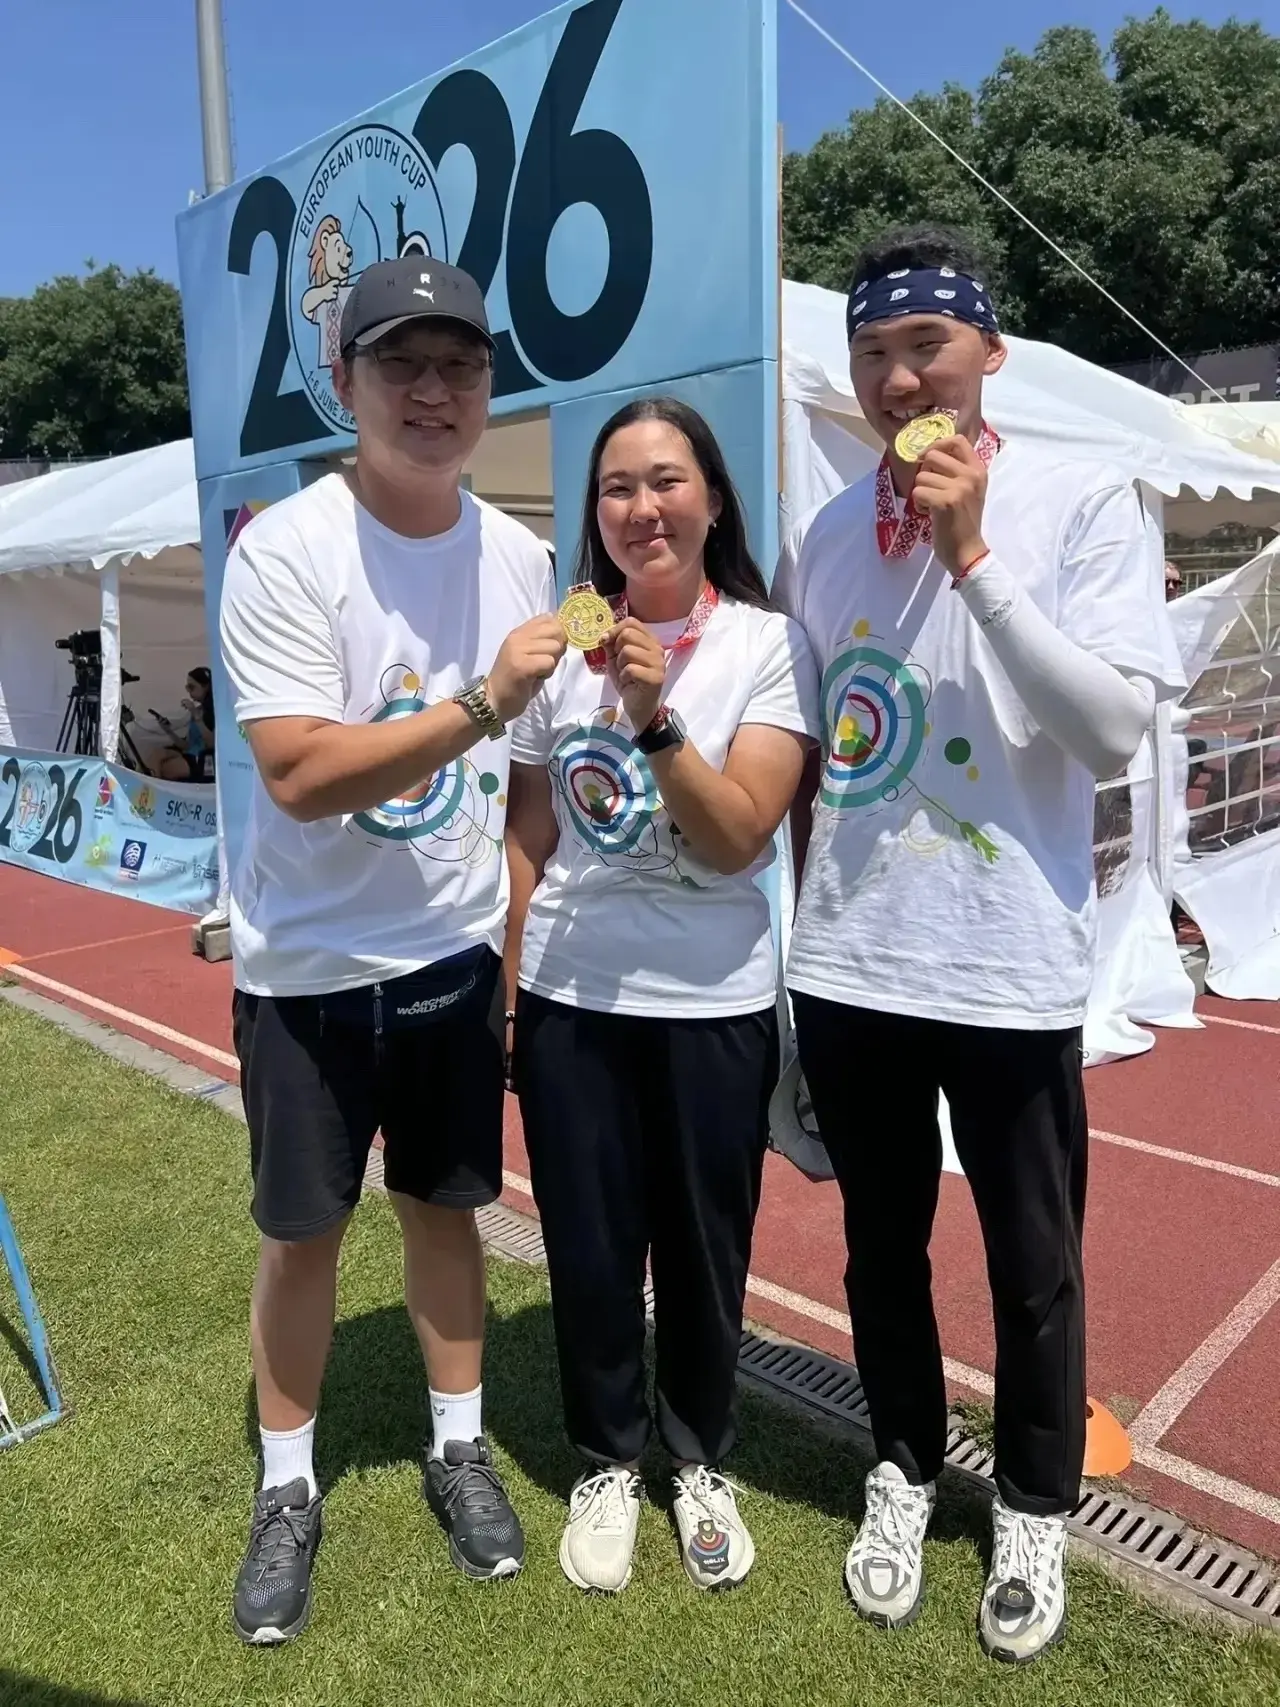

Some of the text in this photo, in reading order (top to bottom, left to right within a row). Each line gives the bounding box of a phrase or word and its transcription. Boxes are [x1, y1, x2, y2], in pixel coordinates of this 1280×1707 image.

[300, 136, 427, 239] EUROPEAN YOUTH CUP
[318, 388, 340, 417] JUNE
[396, 1004, 437, 1015] WORLD
